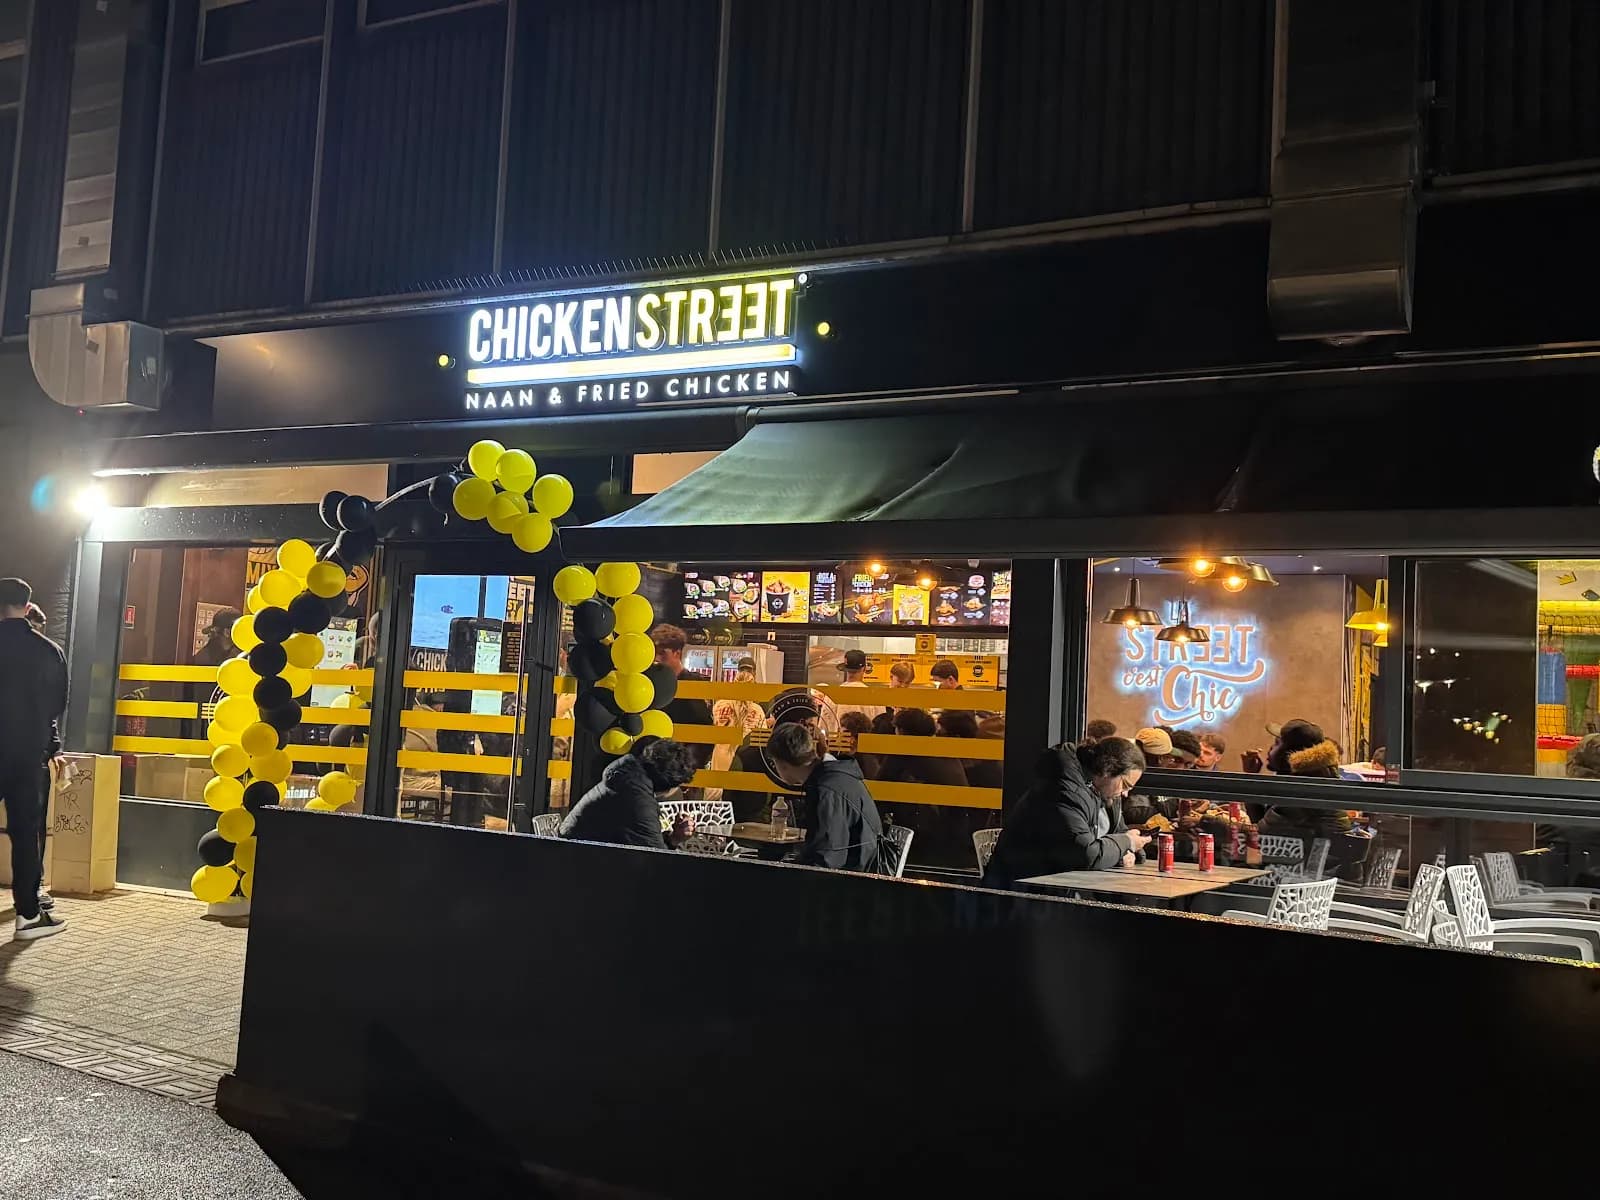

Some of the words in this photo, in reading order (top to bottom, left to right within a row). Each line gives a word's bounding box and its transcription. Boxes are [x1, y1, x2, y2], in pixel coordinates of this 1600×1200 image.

[465, 389, 533, 409] NAAN
[548, 387, 562, 404] &
[577, 381, 650, 402] FRIED
[666, 370, 790, 397] CHICKEN
[1156, 660, 1260, 724] Chic
